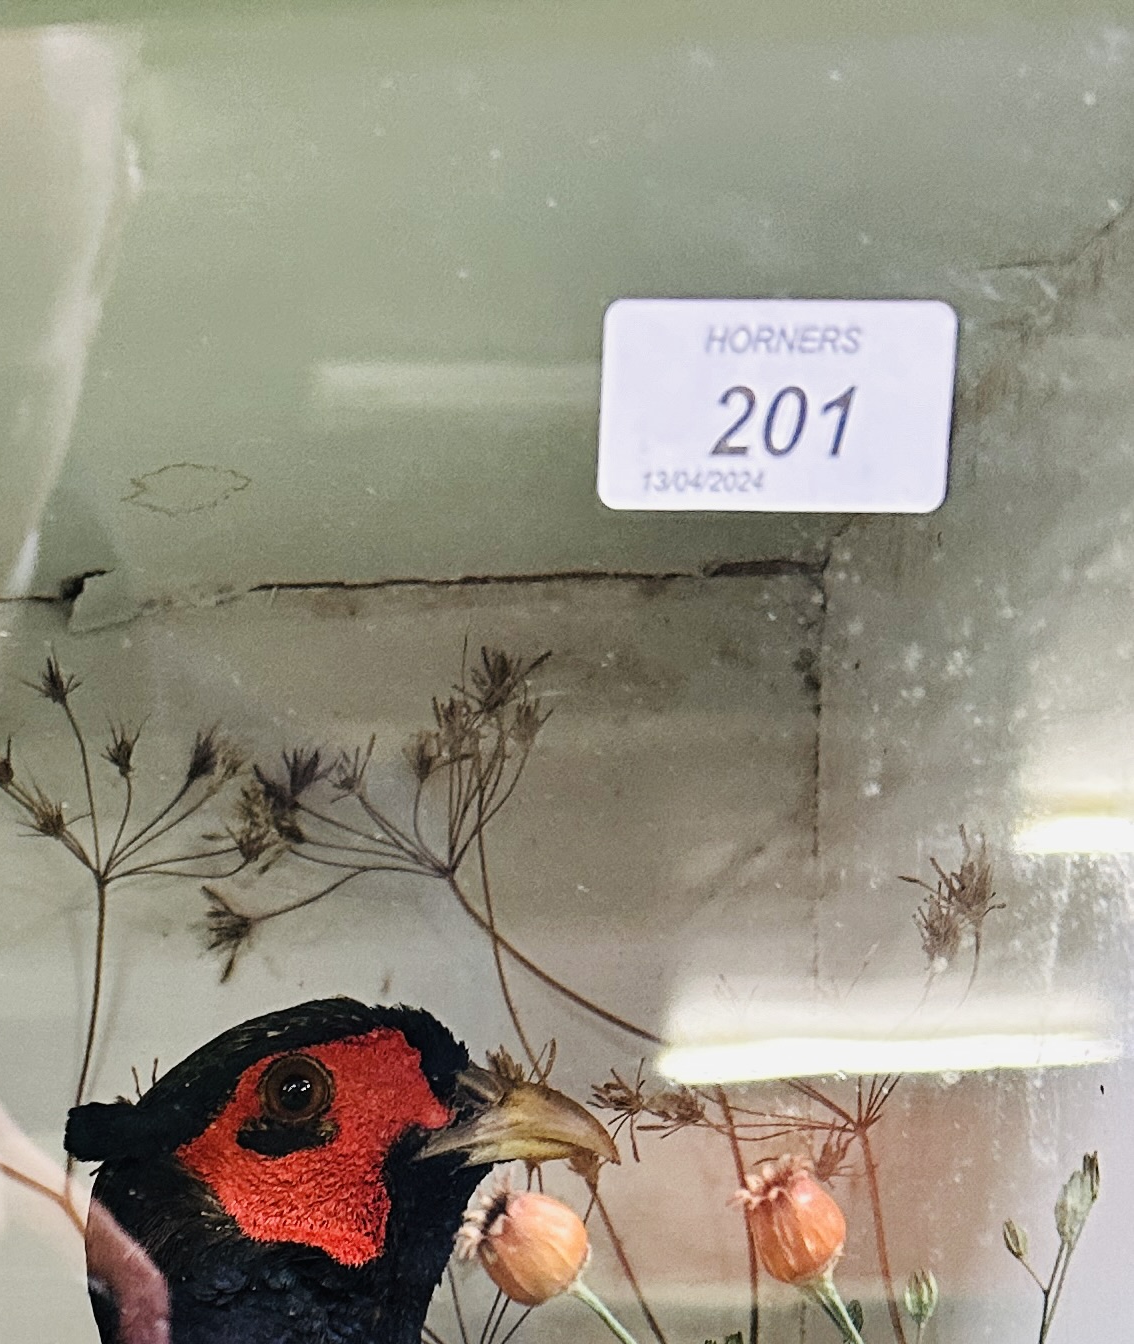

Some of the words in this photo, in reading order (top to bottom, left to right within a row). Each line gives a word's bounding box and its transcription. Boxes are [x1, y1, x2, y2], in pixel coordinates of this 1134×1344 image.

[705, 325, 863, 354] HORNERS
[710, 385, 857, 457] 201
[642, 470, 766, 493] 13/04/2024
